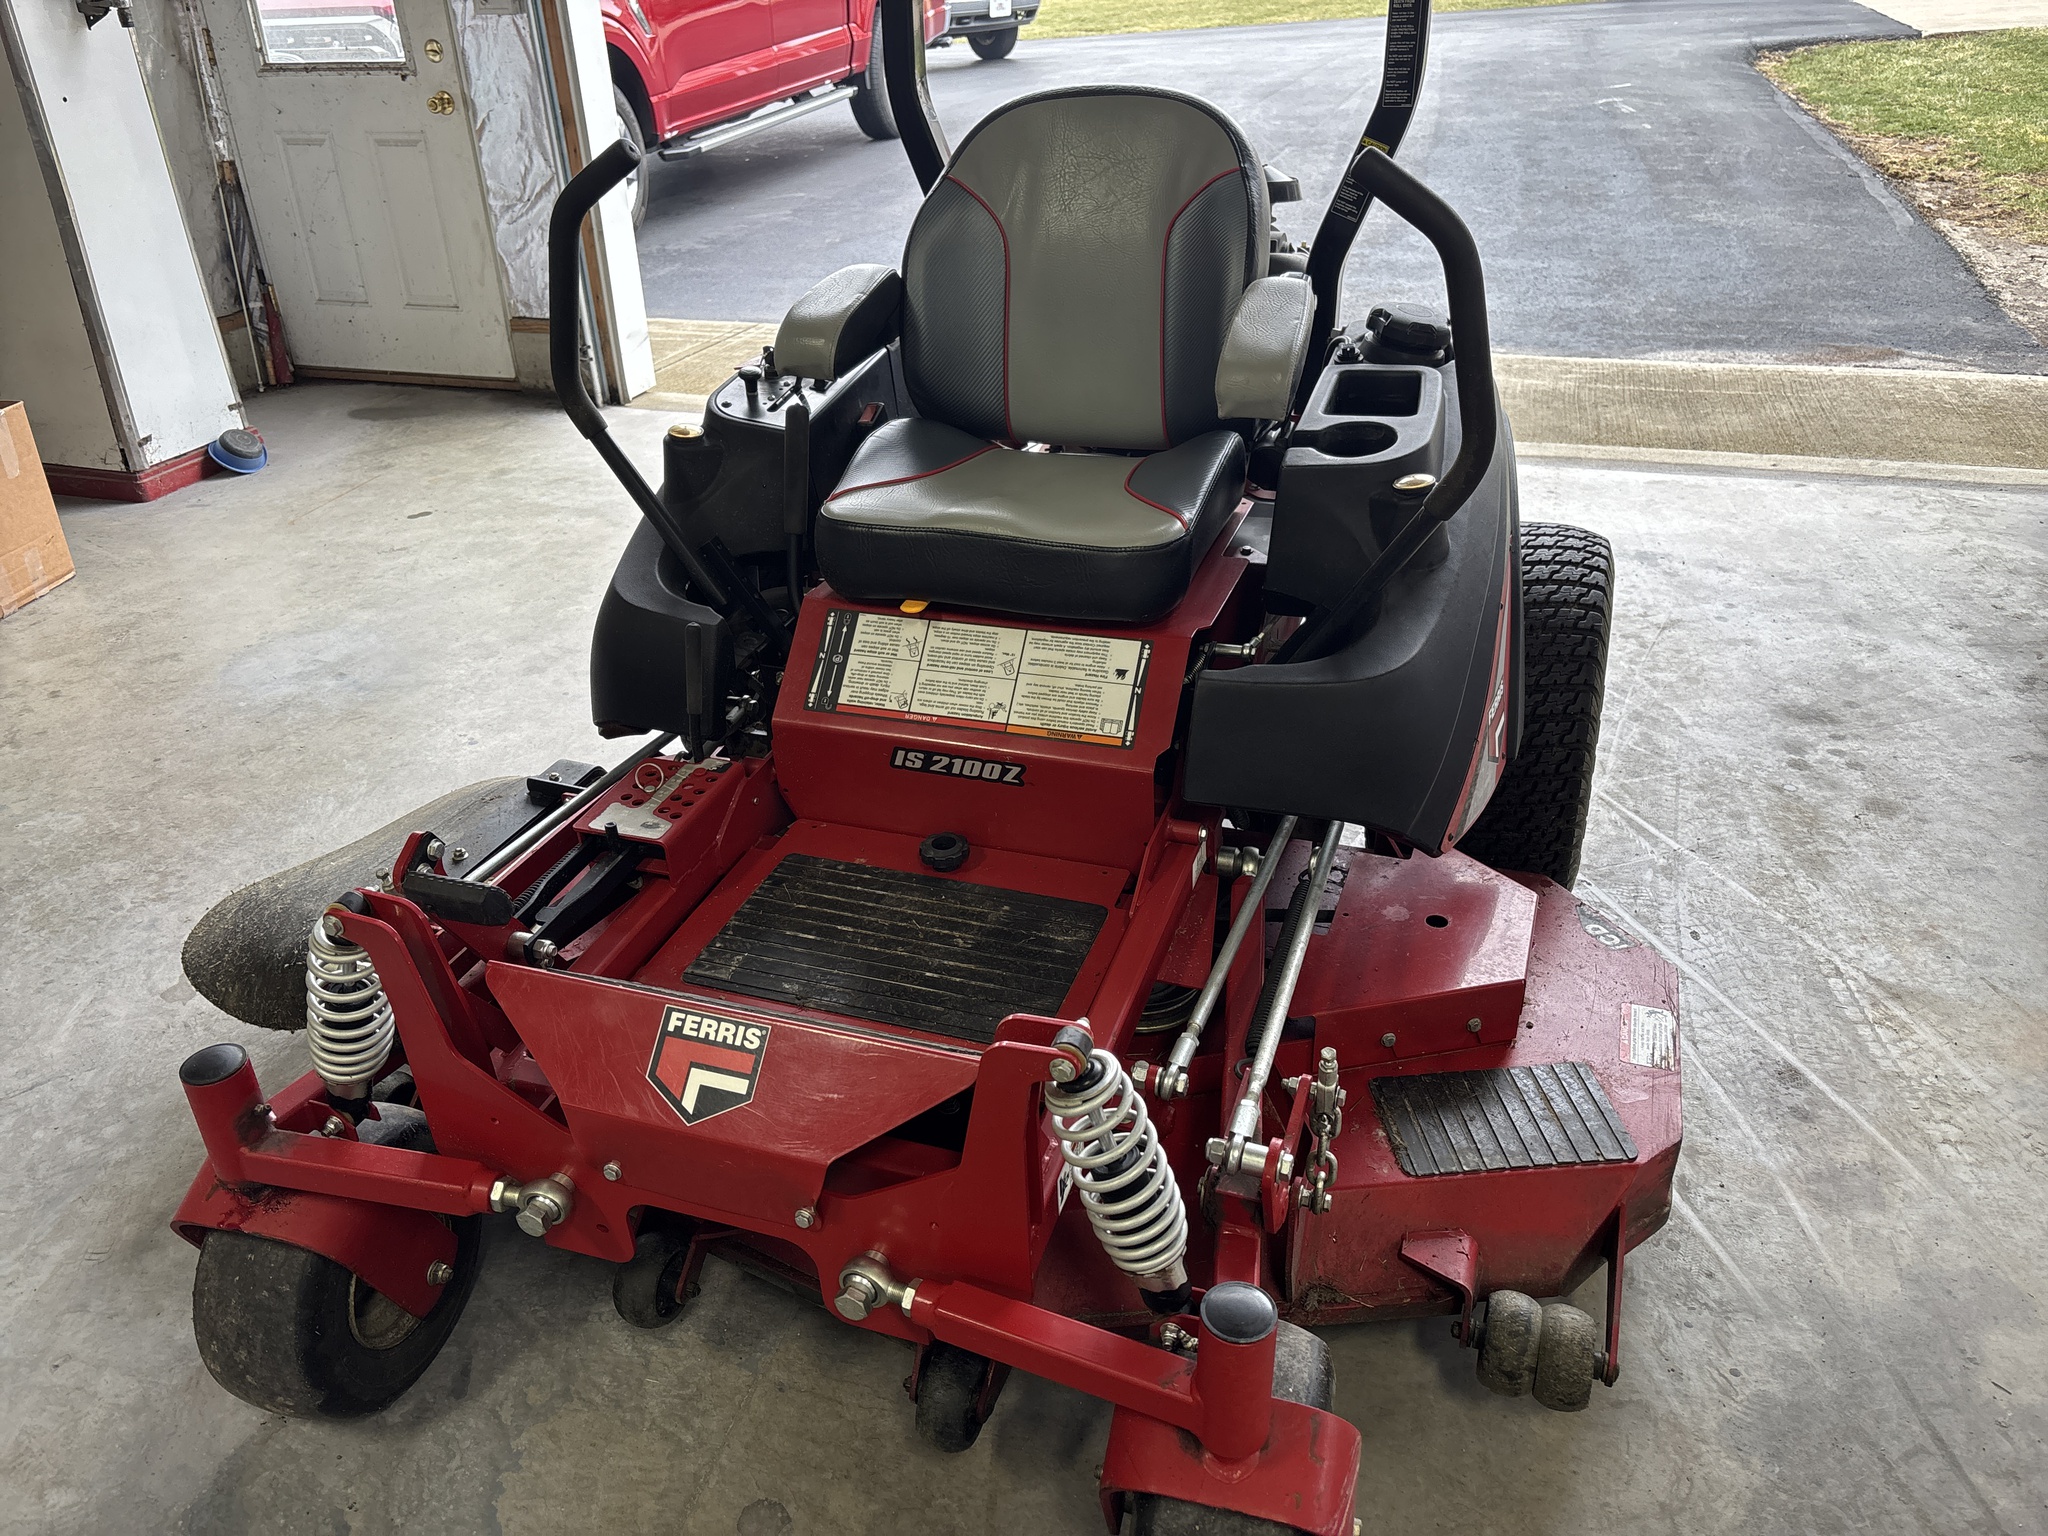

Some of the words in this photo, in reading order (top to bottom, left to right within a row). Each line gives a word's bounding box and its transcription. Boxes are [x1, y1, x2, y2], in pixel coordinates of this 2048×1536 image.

[1046, 730, 1076, 738] WARNING
[894, 750, 924, 768] IS
[930, 756, 1021, 783] 2100Z
[668, 1012, 762, 1050] FERRIS
